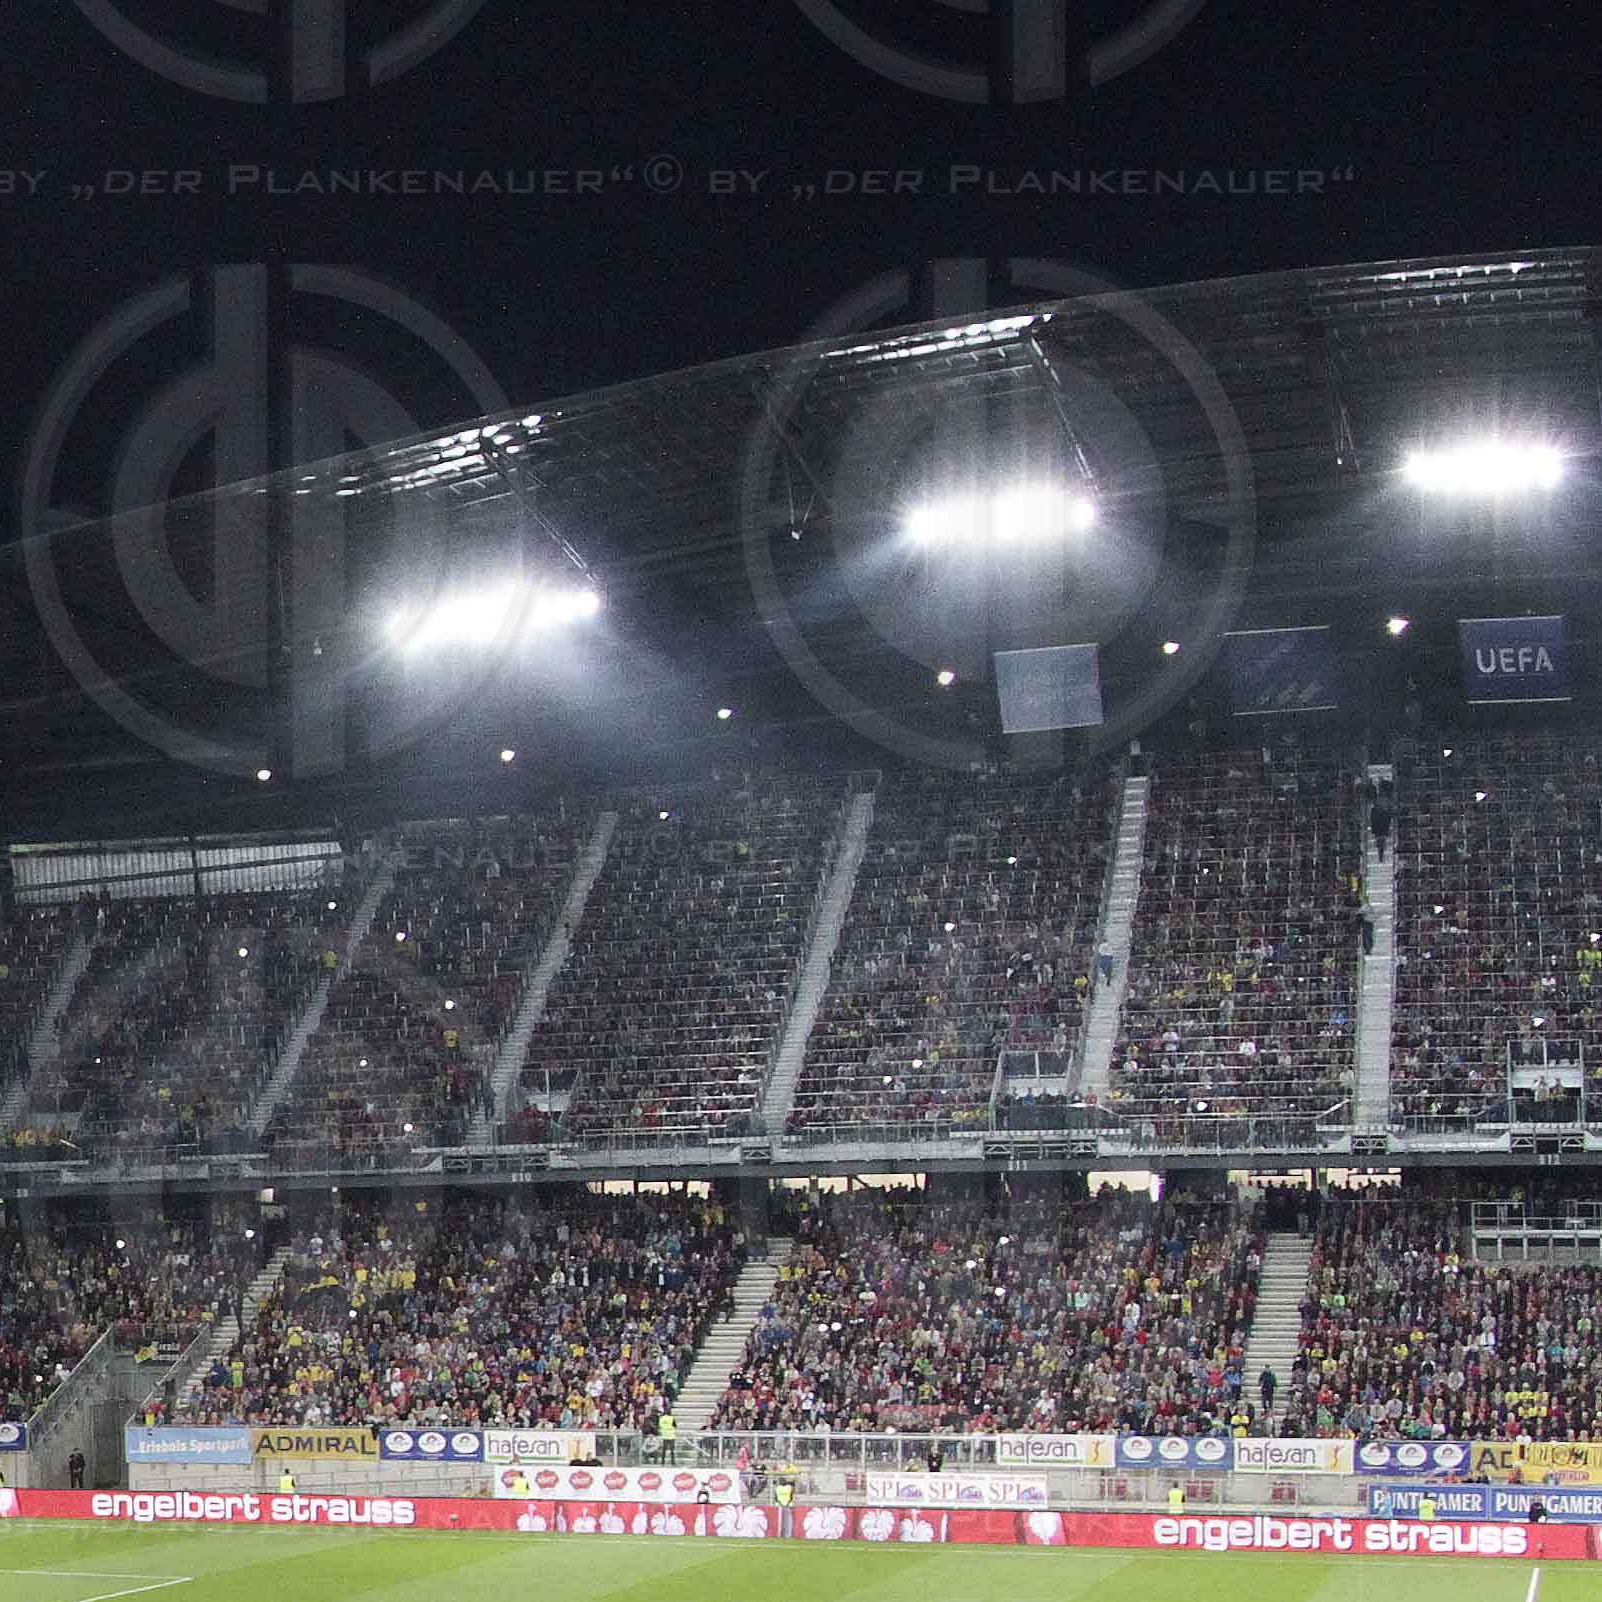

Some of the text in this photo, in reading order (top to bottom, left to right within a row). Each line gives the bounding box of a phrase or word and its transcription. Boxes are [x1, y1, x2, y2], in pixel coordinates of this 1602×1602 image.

[1477, 647, 1553, 674] UEFA
[256, 1434, 376, 1455] ADMIRAL
[488, 1434, 560, 1459] hafesan
[999, 1435, 1077, 1461] hafesan
[1237, 1441, 1316, 1467] hafesan
[91, 1491, 416, 1525] engelbert strauss
[1154, 1516, 1528, 1556] engelbert strauss
